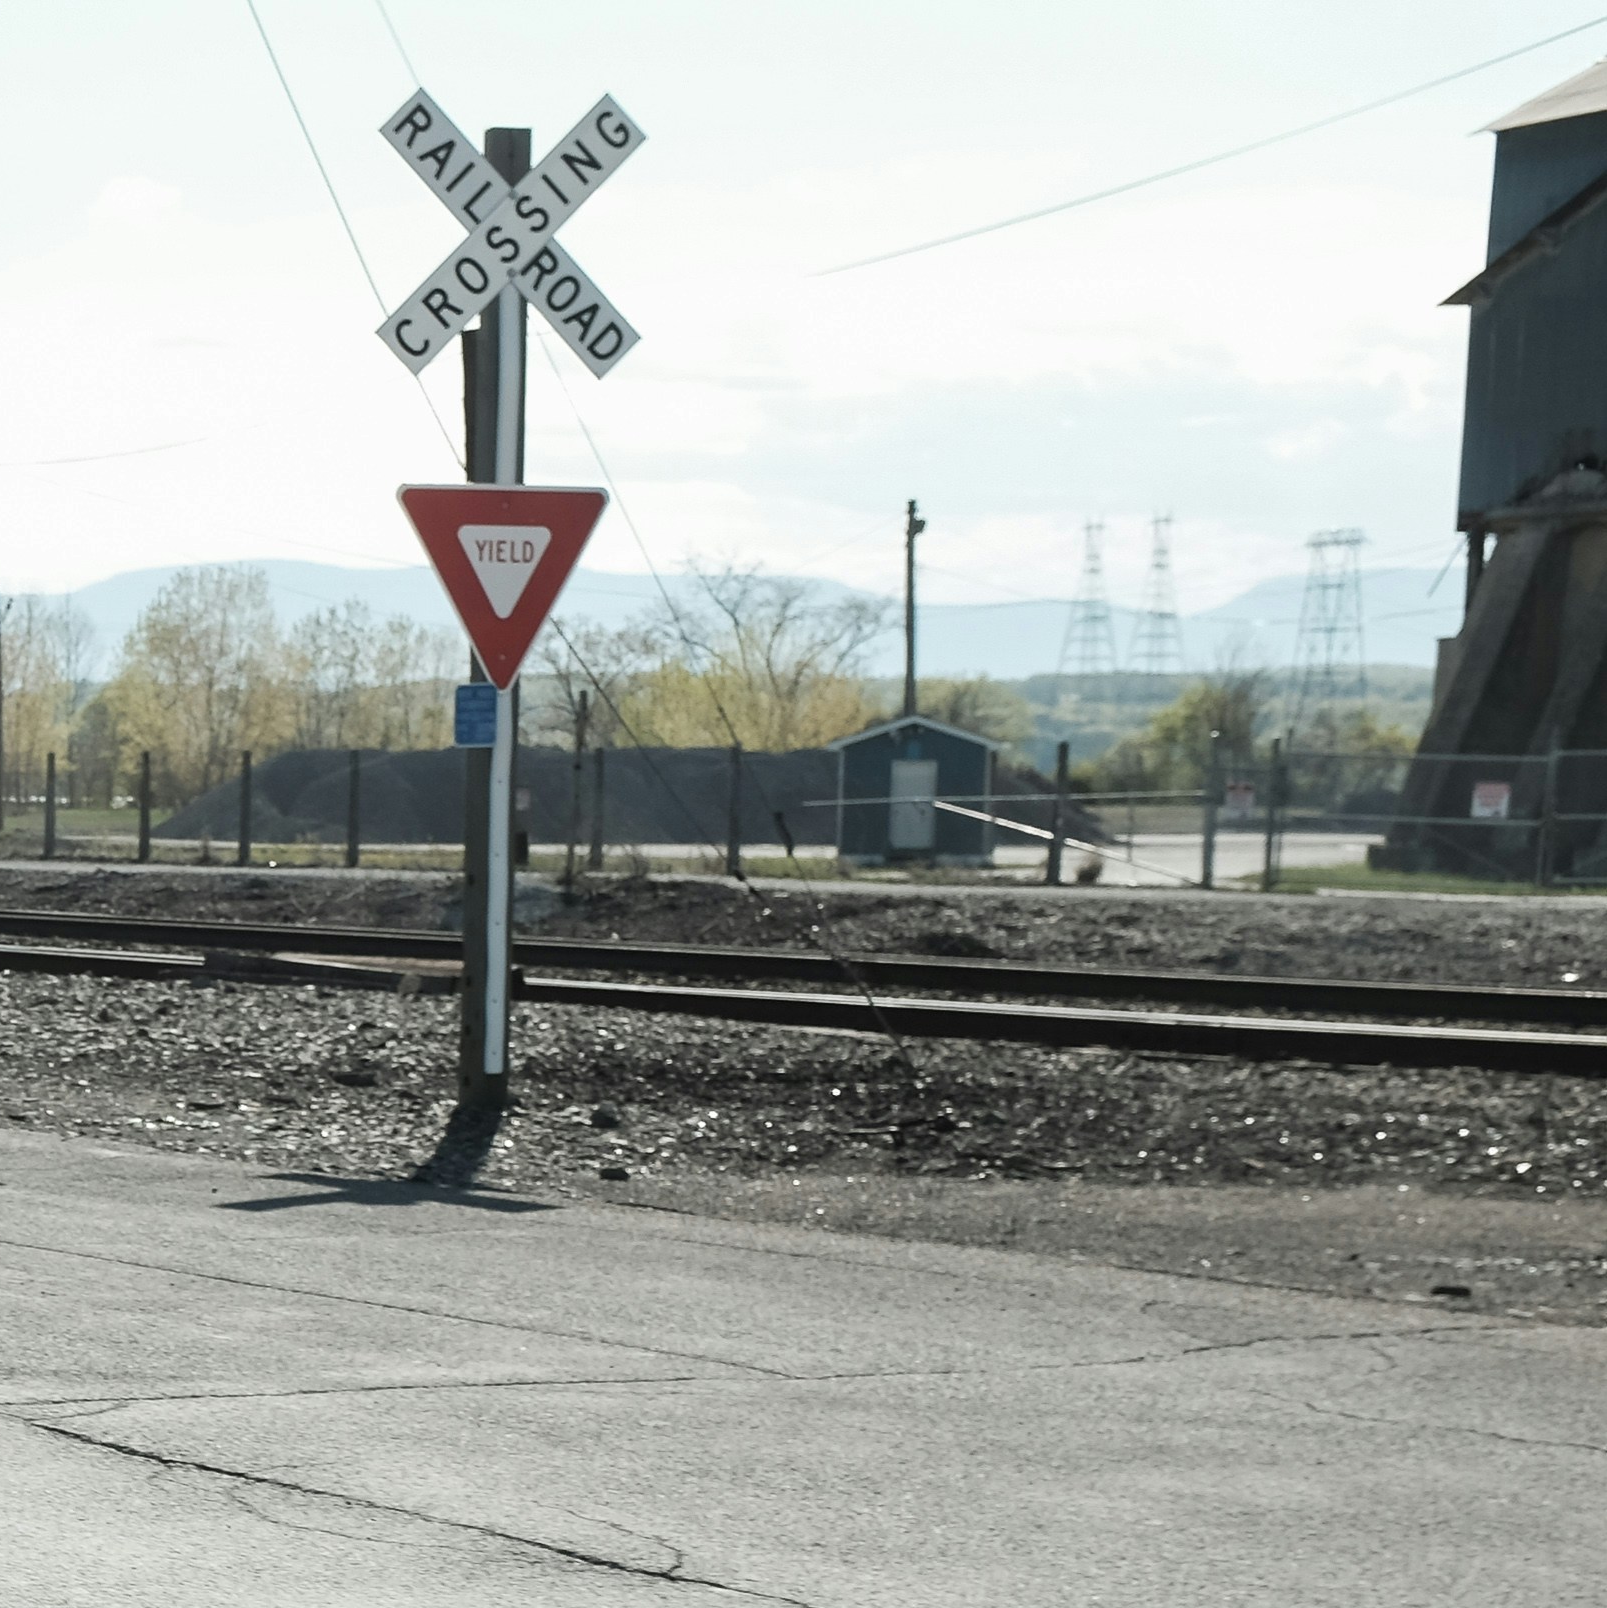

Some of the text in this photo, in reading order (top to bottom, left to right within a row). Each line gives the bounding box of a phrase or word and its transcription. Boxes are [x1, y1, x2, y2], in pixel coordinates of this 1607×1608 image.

[393, 104, 625, 362] RAIL ROAD
[394, 109, 632, 359] CROSSING
[475, 539, 536, 566] YIELD
